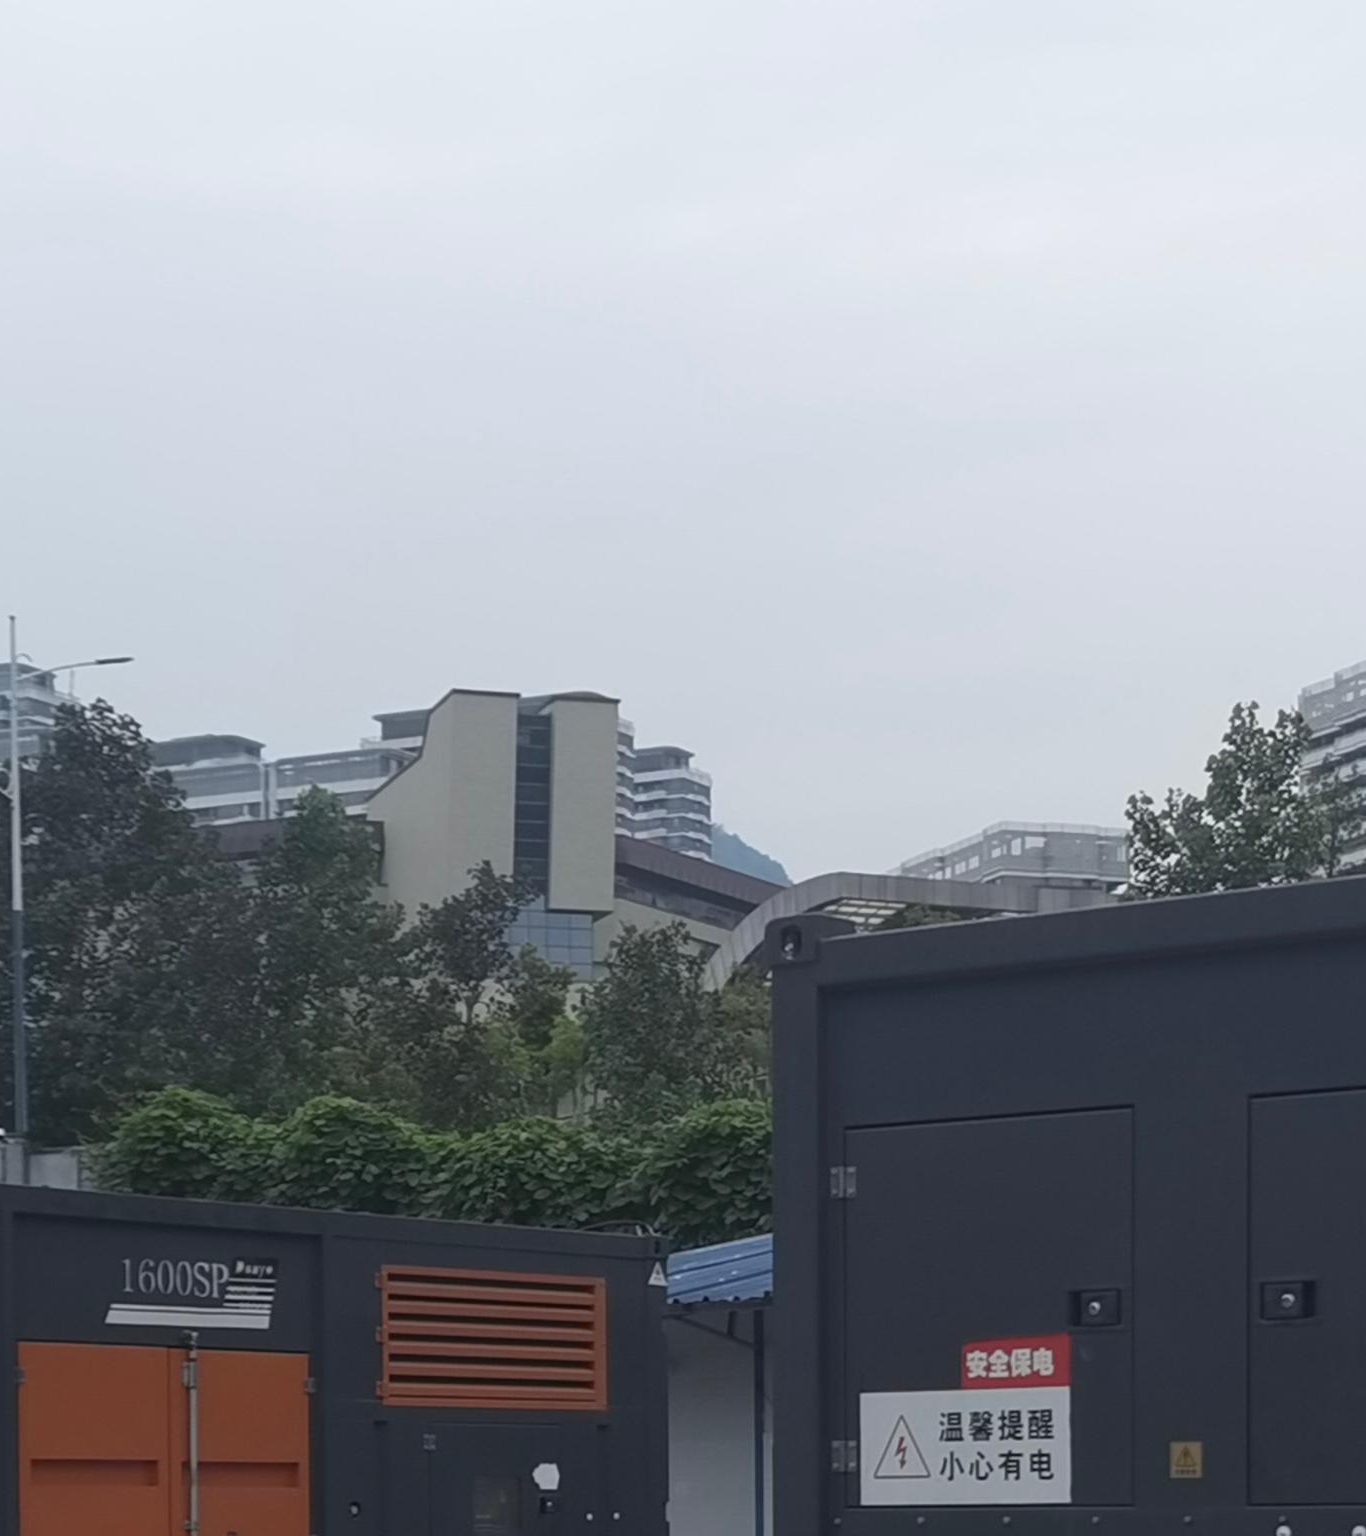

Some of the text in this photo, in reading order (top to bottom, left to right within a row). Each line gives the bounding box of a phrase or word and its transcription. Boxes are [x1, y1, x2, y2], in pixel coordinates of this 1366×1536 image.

[122, 1258, 229, 1298] 1600SP
[966, 1347, 1054, 1378] 安全保电
[939, 1409, 1054, 1442] 温馨提醒
[939, 1449, 1054, 1481] 小心有电
